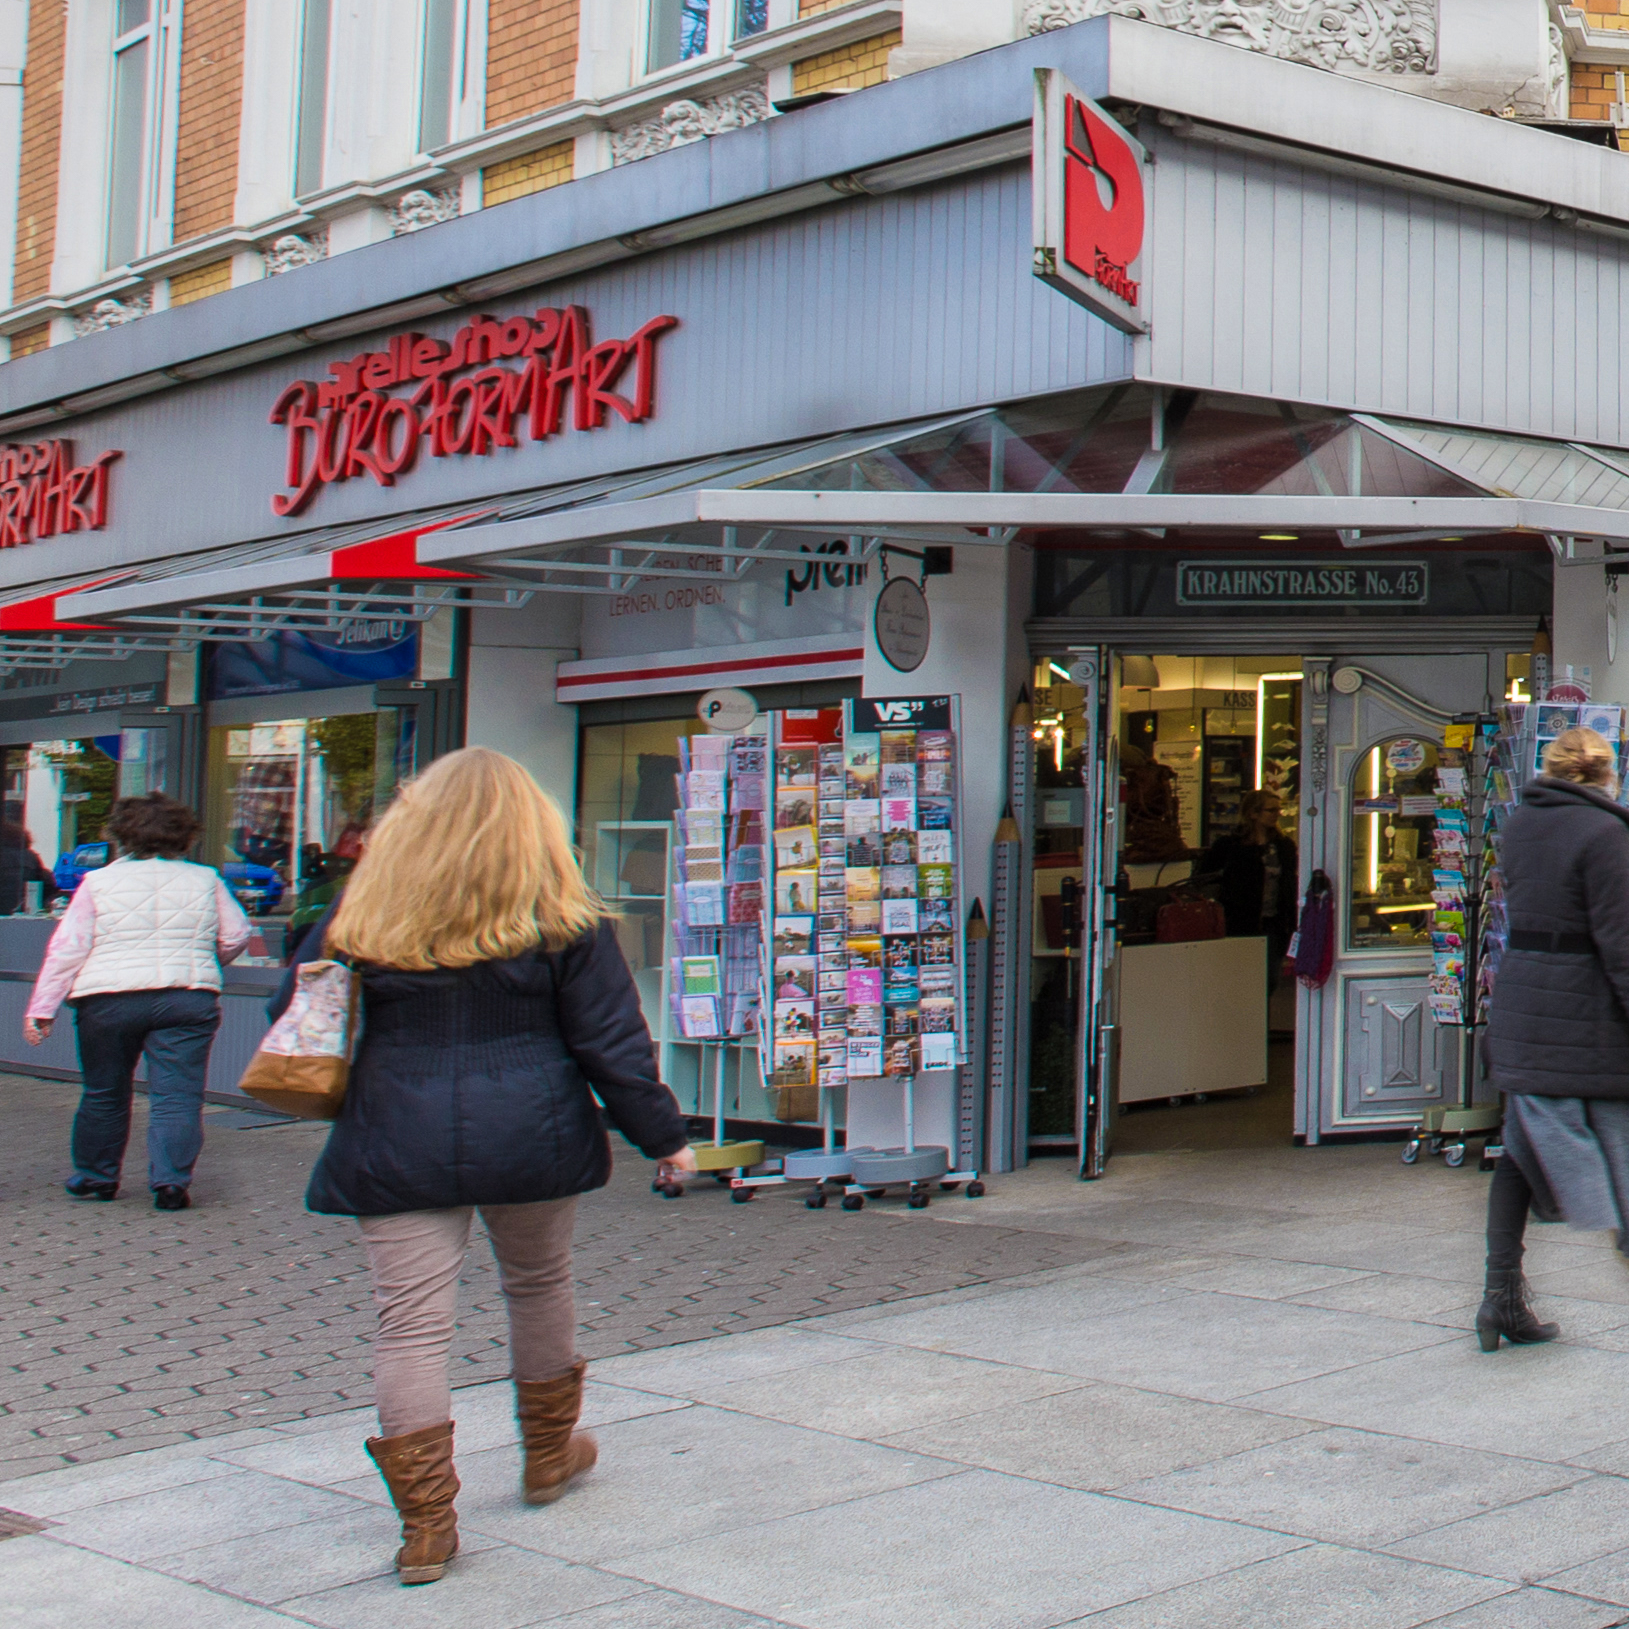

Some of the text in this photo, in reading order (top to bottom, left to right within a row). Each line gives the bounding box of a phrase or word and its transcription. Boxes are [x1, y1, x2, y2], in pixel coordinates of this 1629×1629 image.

[1187, 570, 1357, 596] KRAHNSTRASSE
[609, 584, 727, 617] LERNEN. ORDNEN.
[1223, 691, 1258, 708] KASS
